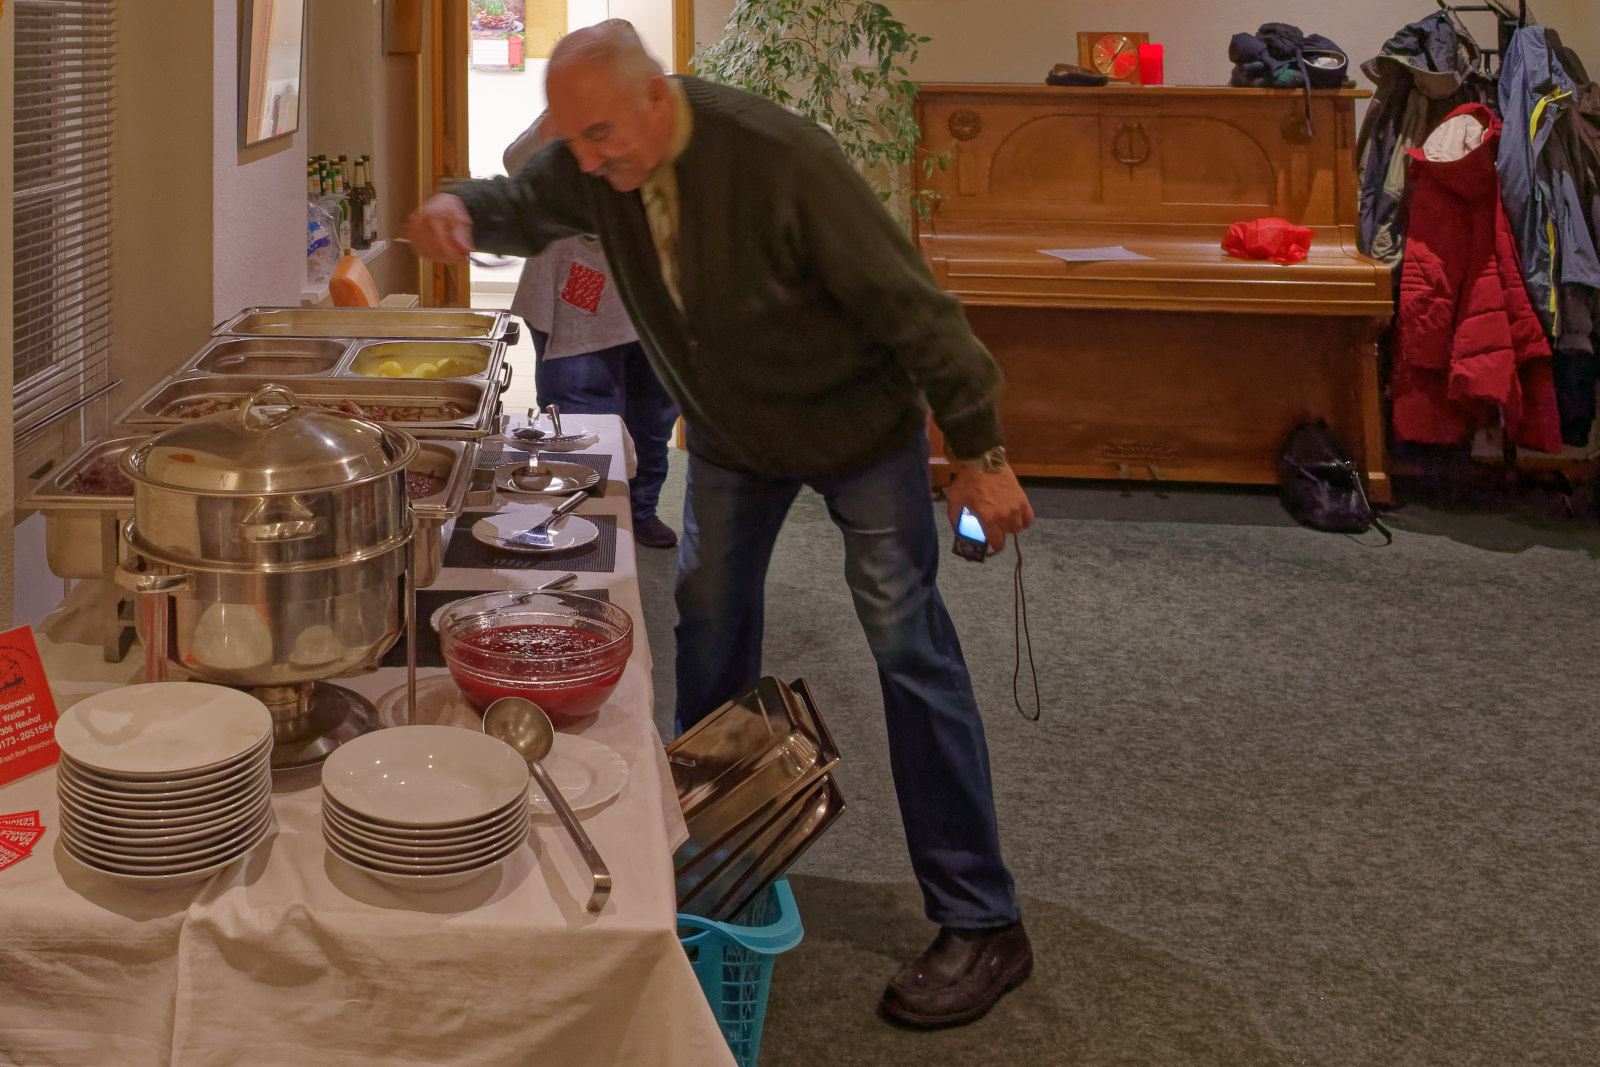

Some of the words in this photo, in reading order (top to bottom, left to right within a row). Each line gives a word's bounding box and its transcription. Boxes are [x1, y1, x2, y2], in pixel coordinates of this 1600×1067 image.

[2, 710, 25, 722] Walde
[26, 706, 31, 714] 7
[15, 714, 41, 729] Neuhof
